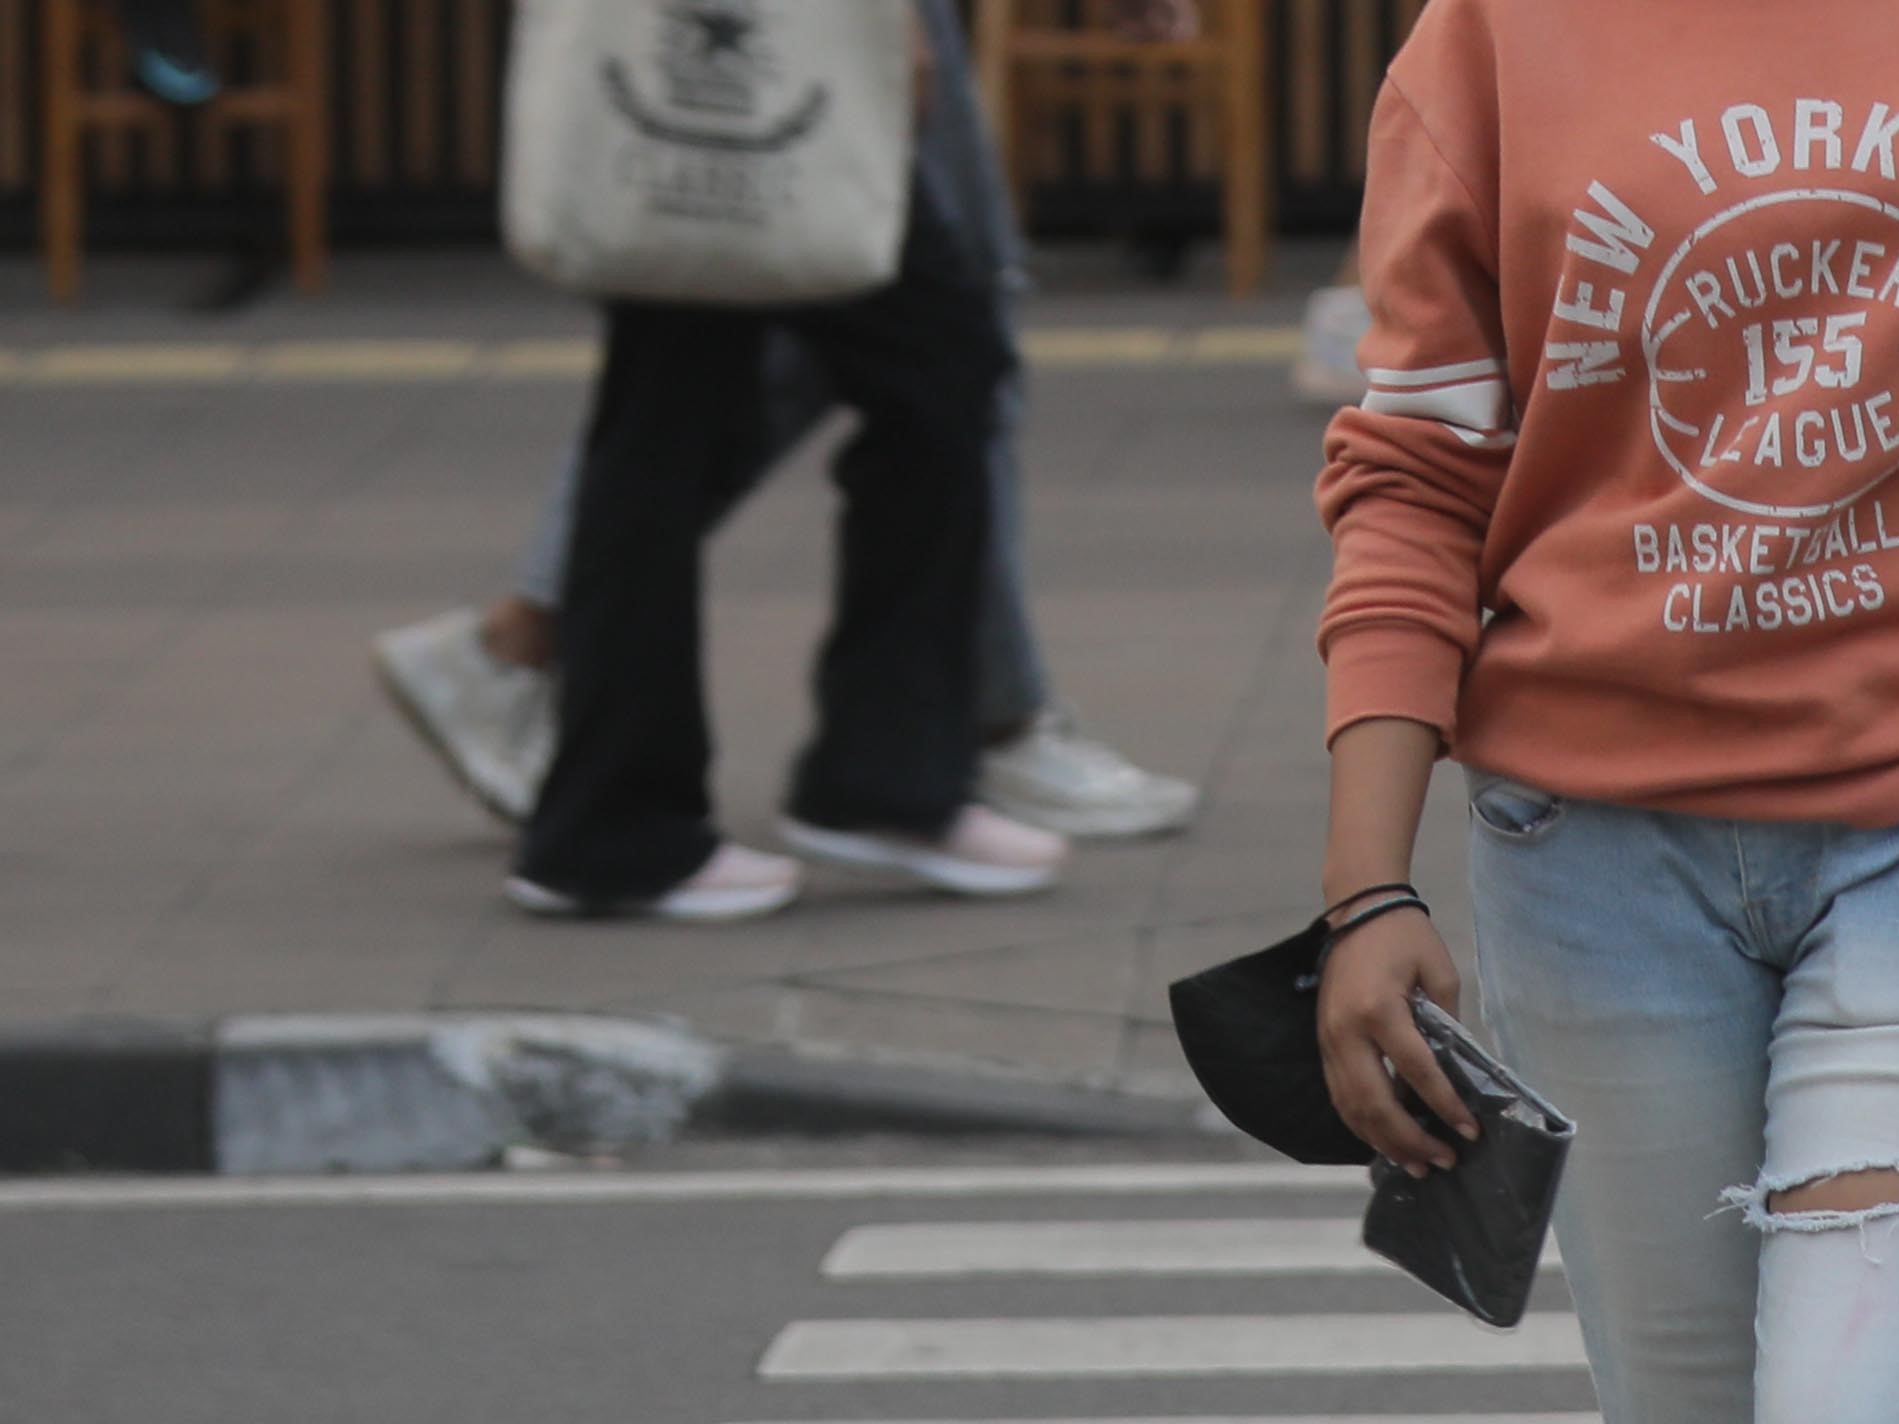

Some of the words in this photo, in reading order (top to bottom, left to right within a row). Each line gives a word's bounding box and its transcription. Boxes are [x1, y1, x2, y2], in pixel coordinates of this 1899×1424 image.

[1545, 180, 1656, 391] NEW
[1741, 311, 1868, 406] 155
[1662, 563, 1886, 633] CLASSICS
